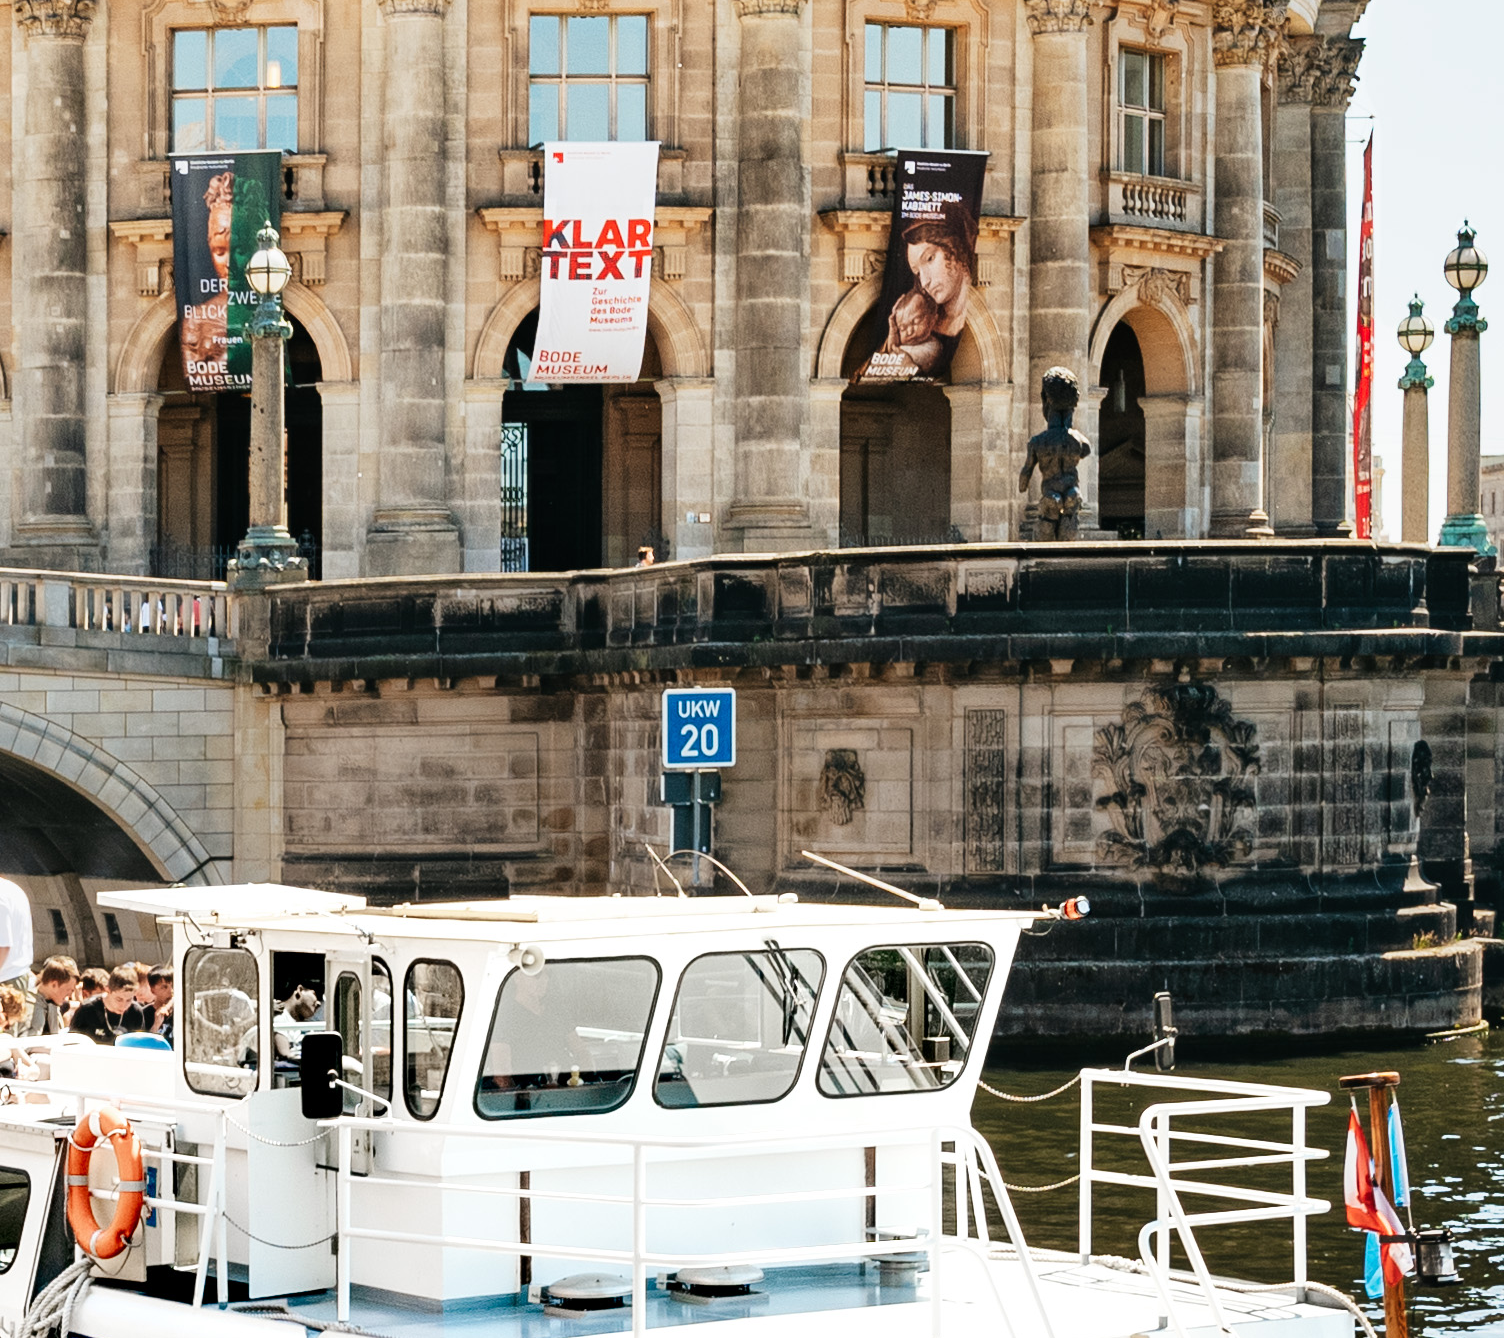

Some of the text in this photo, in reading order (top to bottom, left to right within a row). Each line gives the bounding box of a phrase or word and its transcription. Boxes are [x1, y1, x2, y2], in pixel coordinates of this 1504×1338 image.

[543, 219, 652, 249] KLAR
[541, 249, 652, 280] TEXT
[200, 278, 229, 293] DER
[593, 287, 607, 295] Zur
[592, 296, 642, 305] Geschichte
[184, 304, 228, 319] BLICK
[610, 306, 635, 314] Bode-
[590, 316, 633, 324] Museums
[212, 335, 244, 344] Frauen
[539, 350, 582, 362] BODE
[871, 352, 905, 365] BODE
[187, 360, 229, 374] BODE
[536, 364, 608, 375] MUSEUM
[865, 365, 919, 376] MUSEUM
[678, 699, 721, 718] UKW
[680, 723, 719, 757] 20
